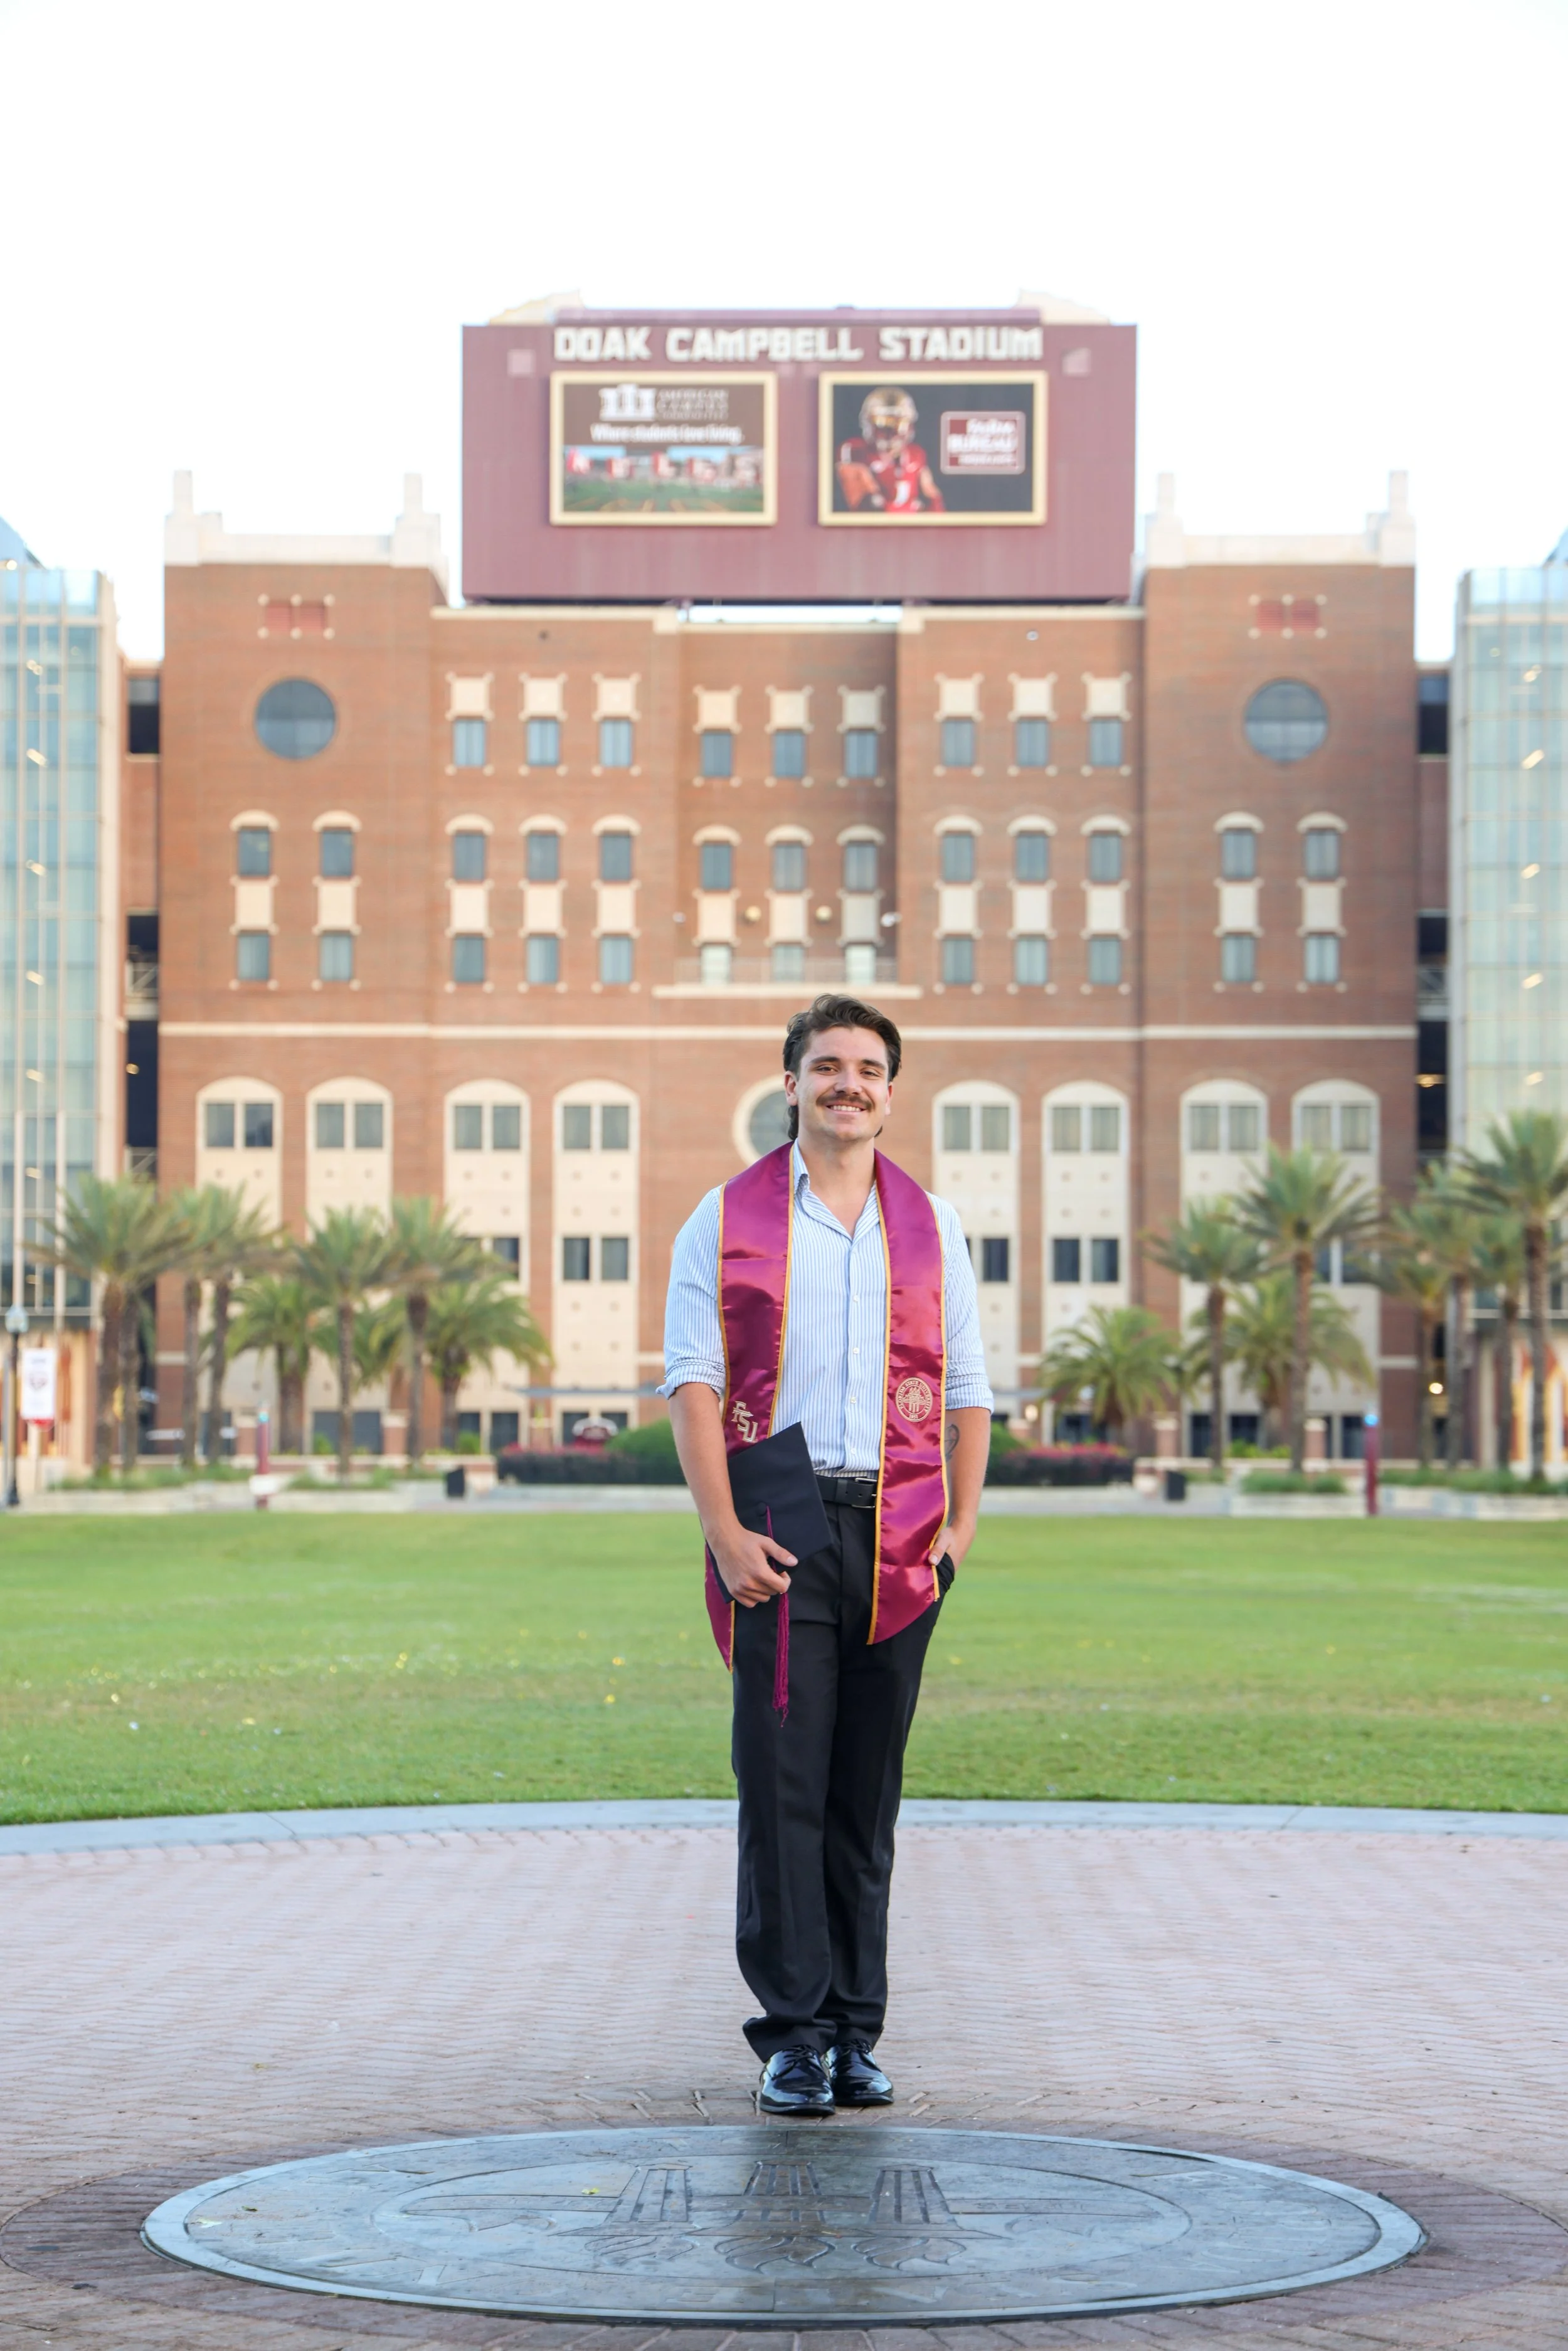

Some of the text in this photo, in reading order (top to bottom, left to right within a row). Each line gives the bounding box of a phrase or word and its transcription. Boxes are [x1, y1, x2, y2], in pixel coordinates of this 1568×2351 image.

[554, 326, 1043, 361] DOAK CAMPBELL STADIUM
[731, 1400, 758, 1443] FSU
